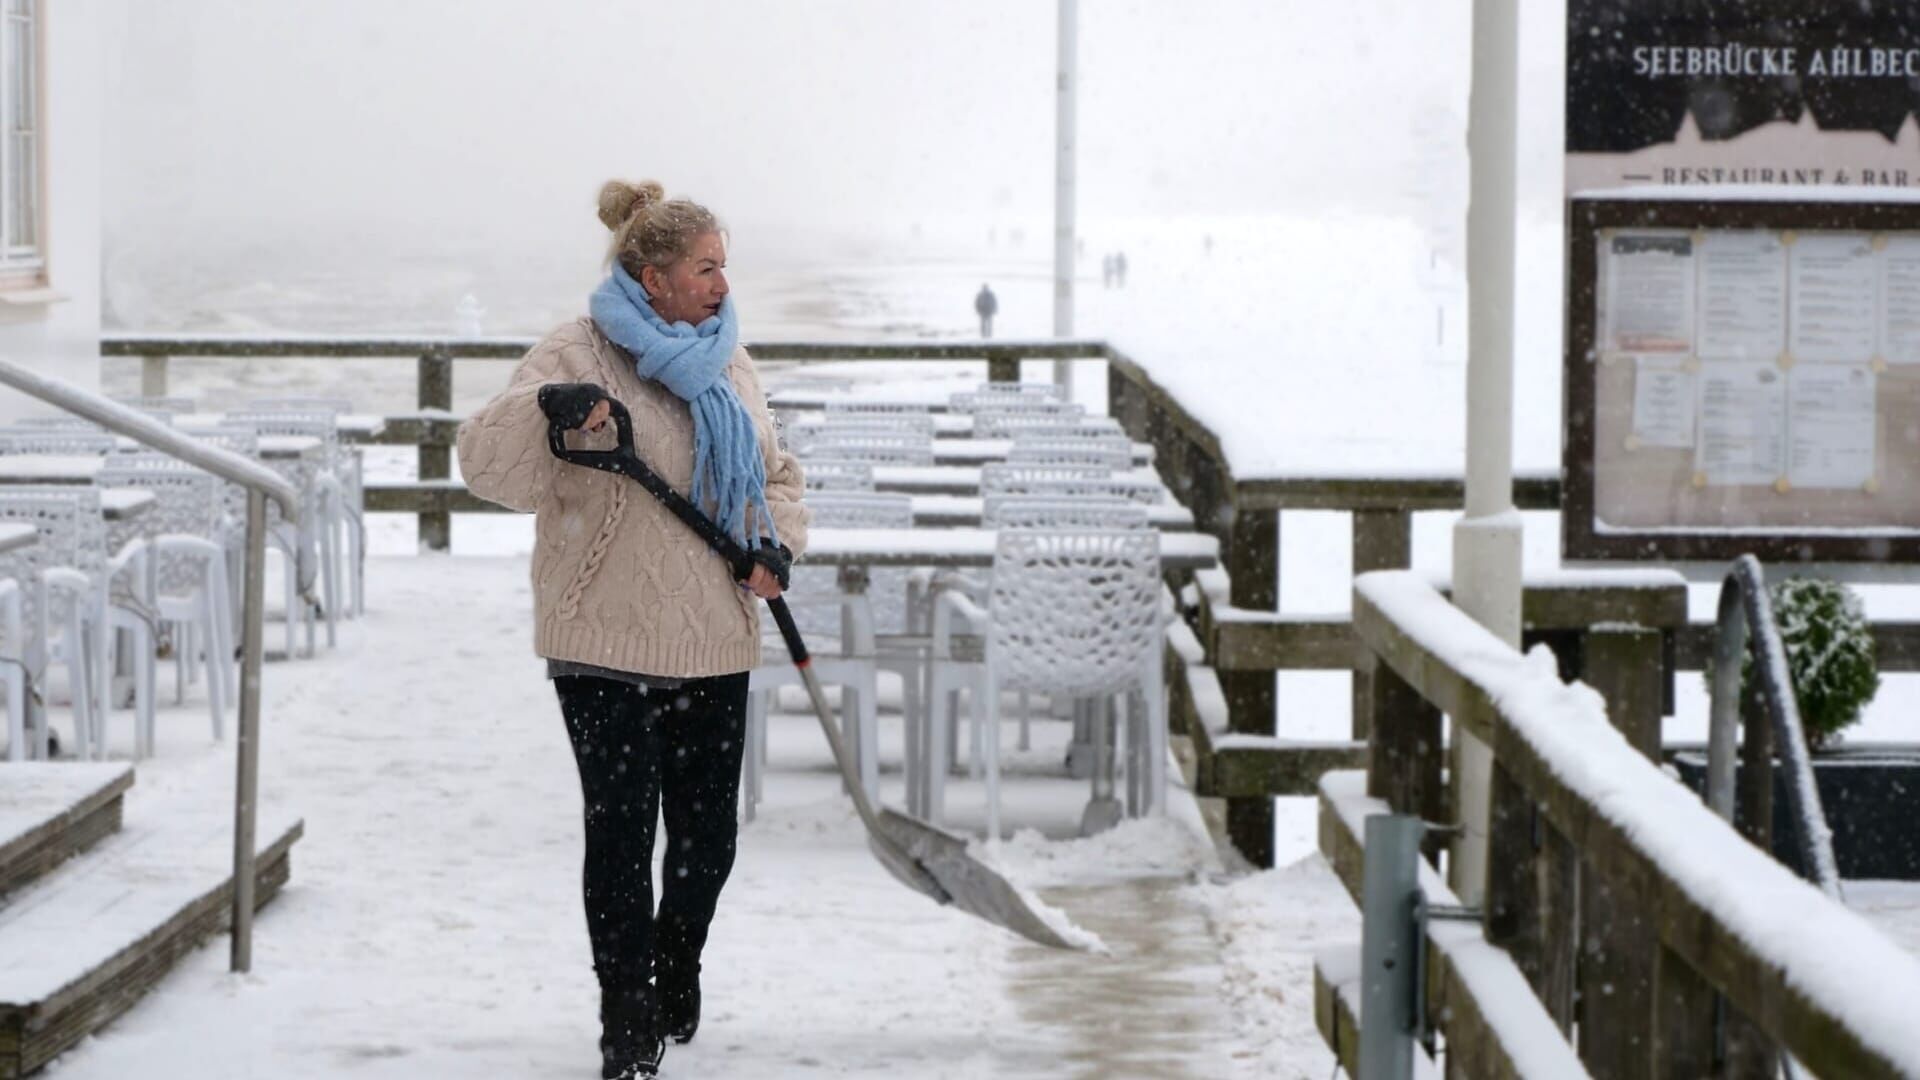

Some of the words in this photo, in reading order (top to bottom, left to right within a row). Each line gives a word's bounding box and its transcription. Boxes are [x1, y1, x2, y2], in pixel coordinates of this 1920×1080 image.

[1633, 43, 1797, 76] SEEBRÜCKE
[1808, 48, 1920, 77] AHLBEC
[1662, 168, 1824, 186] RESTAURANT
[1862, 169, 1909, 187] BAR
